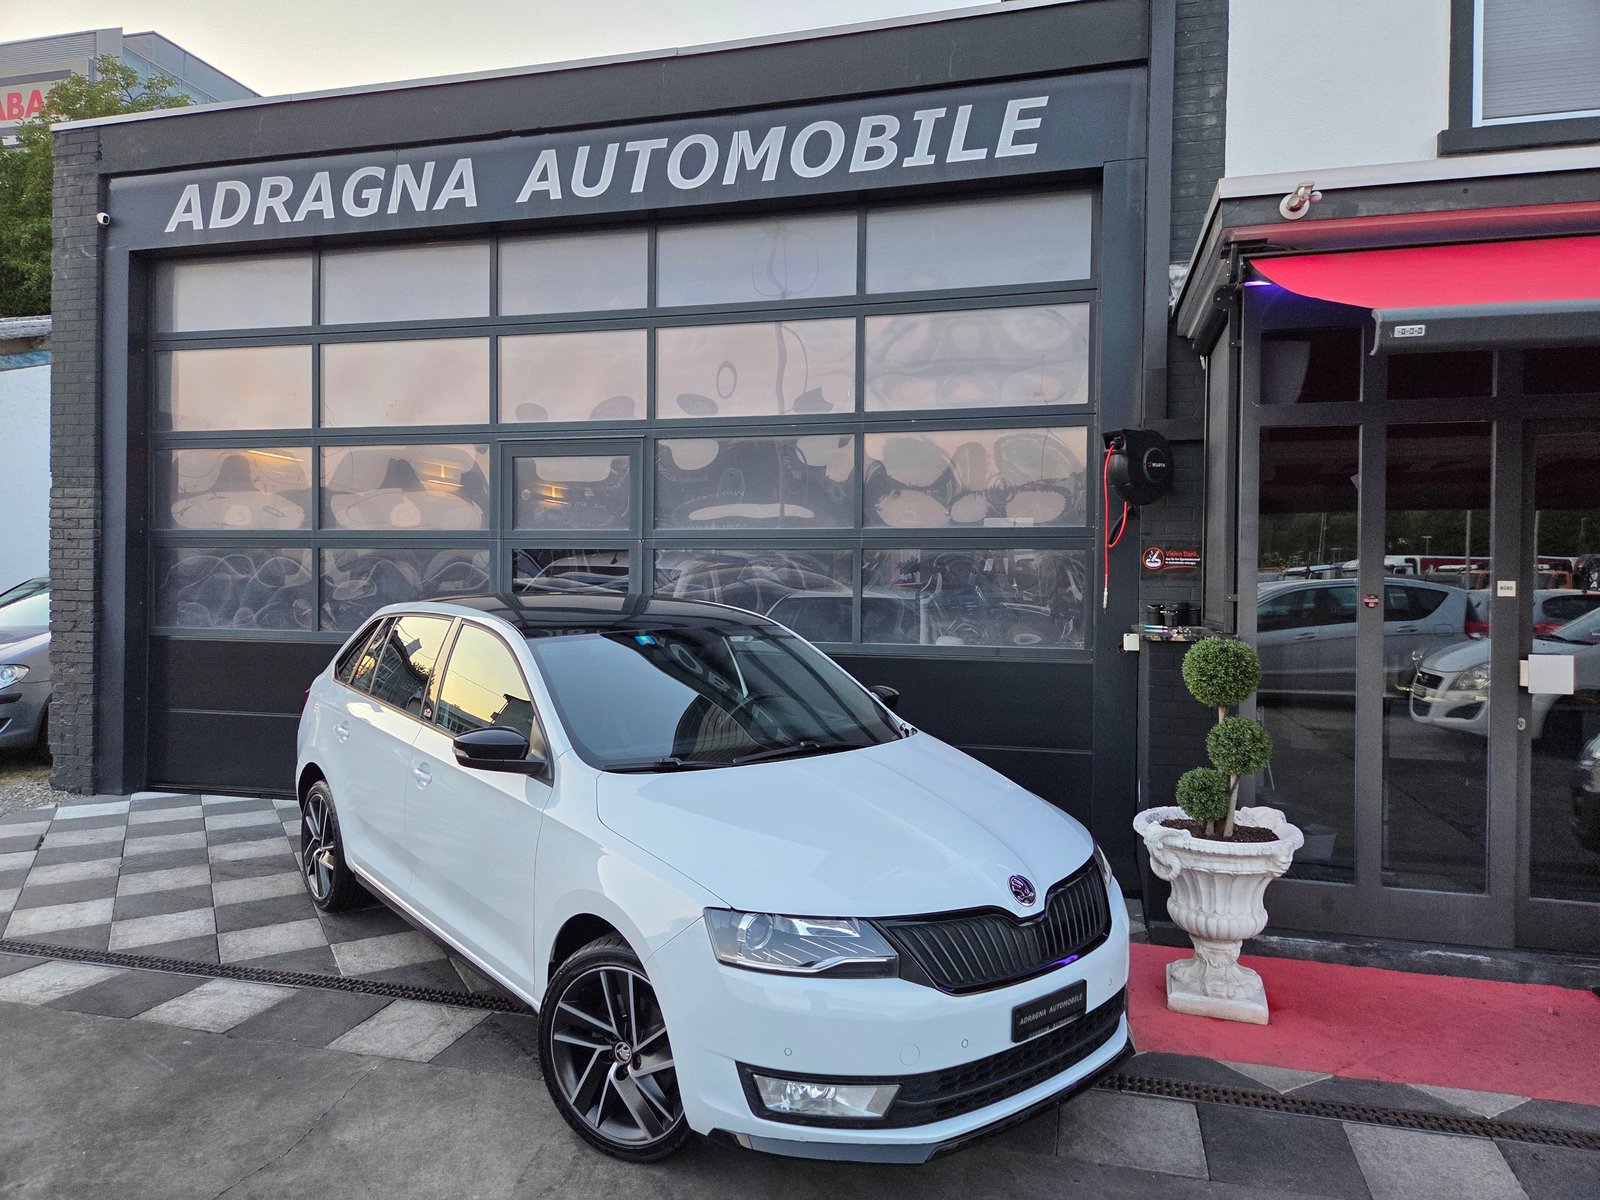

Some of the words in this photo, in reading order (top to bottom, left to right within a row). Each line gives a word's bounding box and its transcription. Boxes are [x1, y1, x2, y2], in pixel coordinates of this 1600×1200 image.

[164, 157, 478, 233] ADRAGNA
[515, 95, 1049, 203] AUTOMOBILE
[1019, 1009, 1047, 1025] ADRAGNA
[1049, 994, 1083, 1013] AUTOMOBILE
